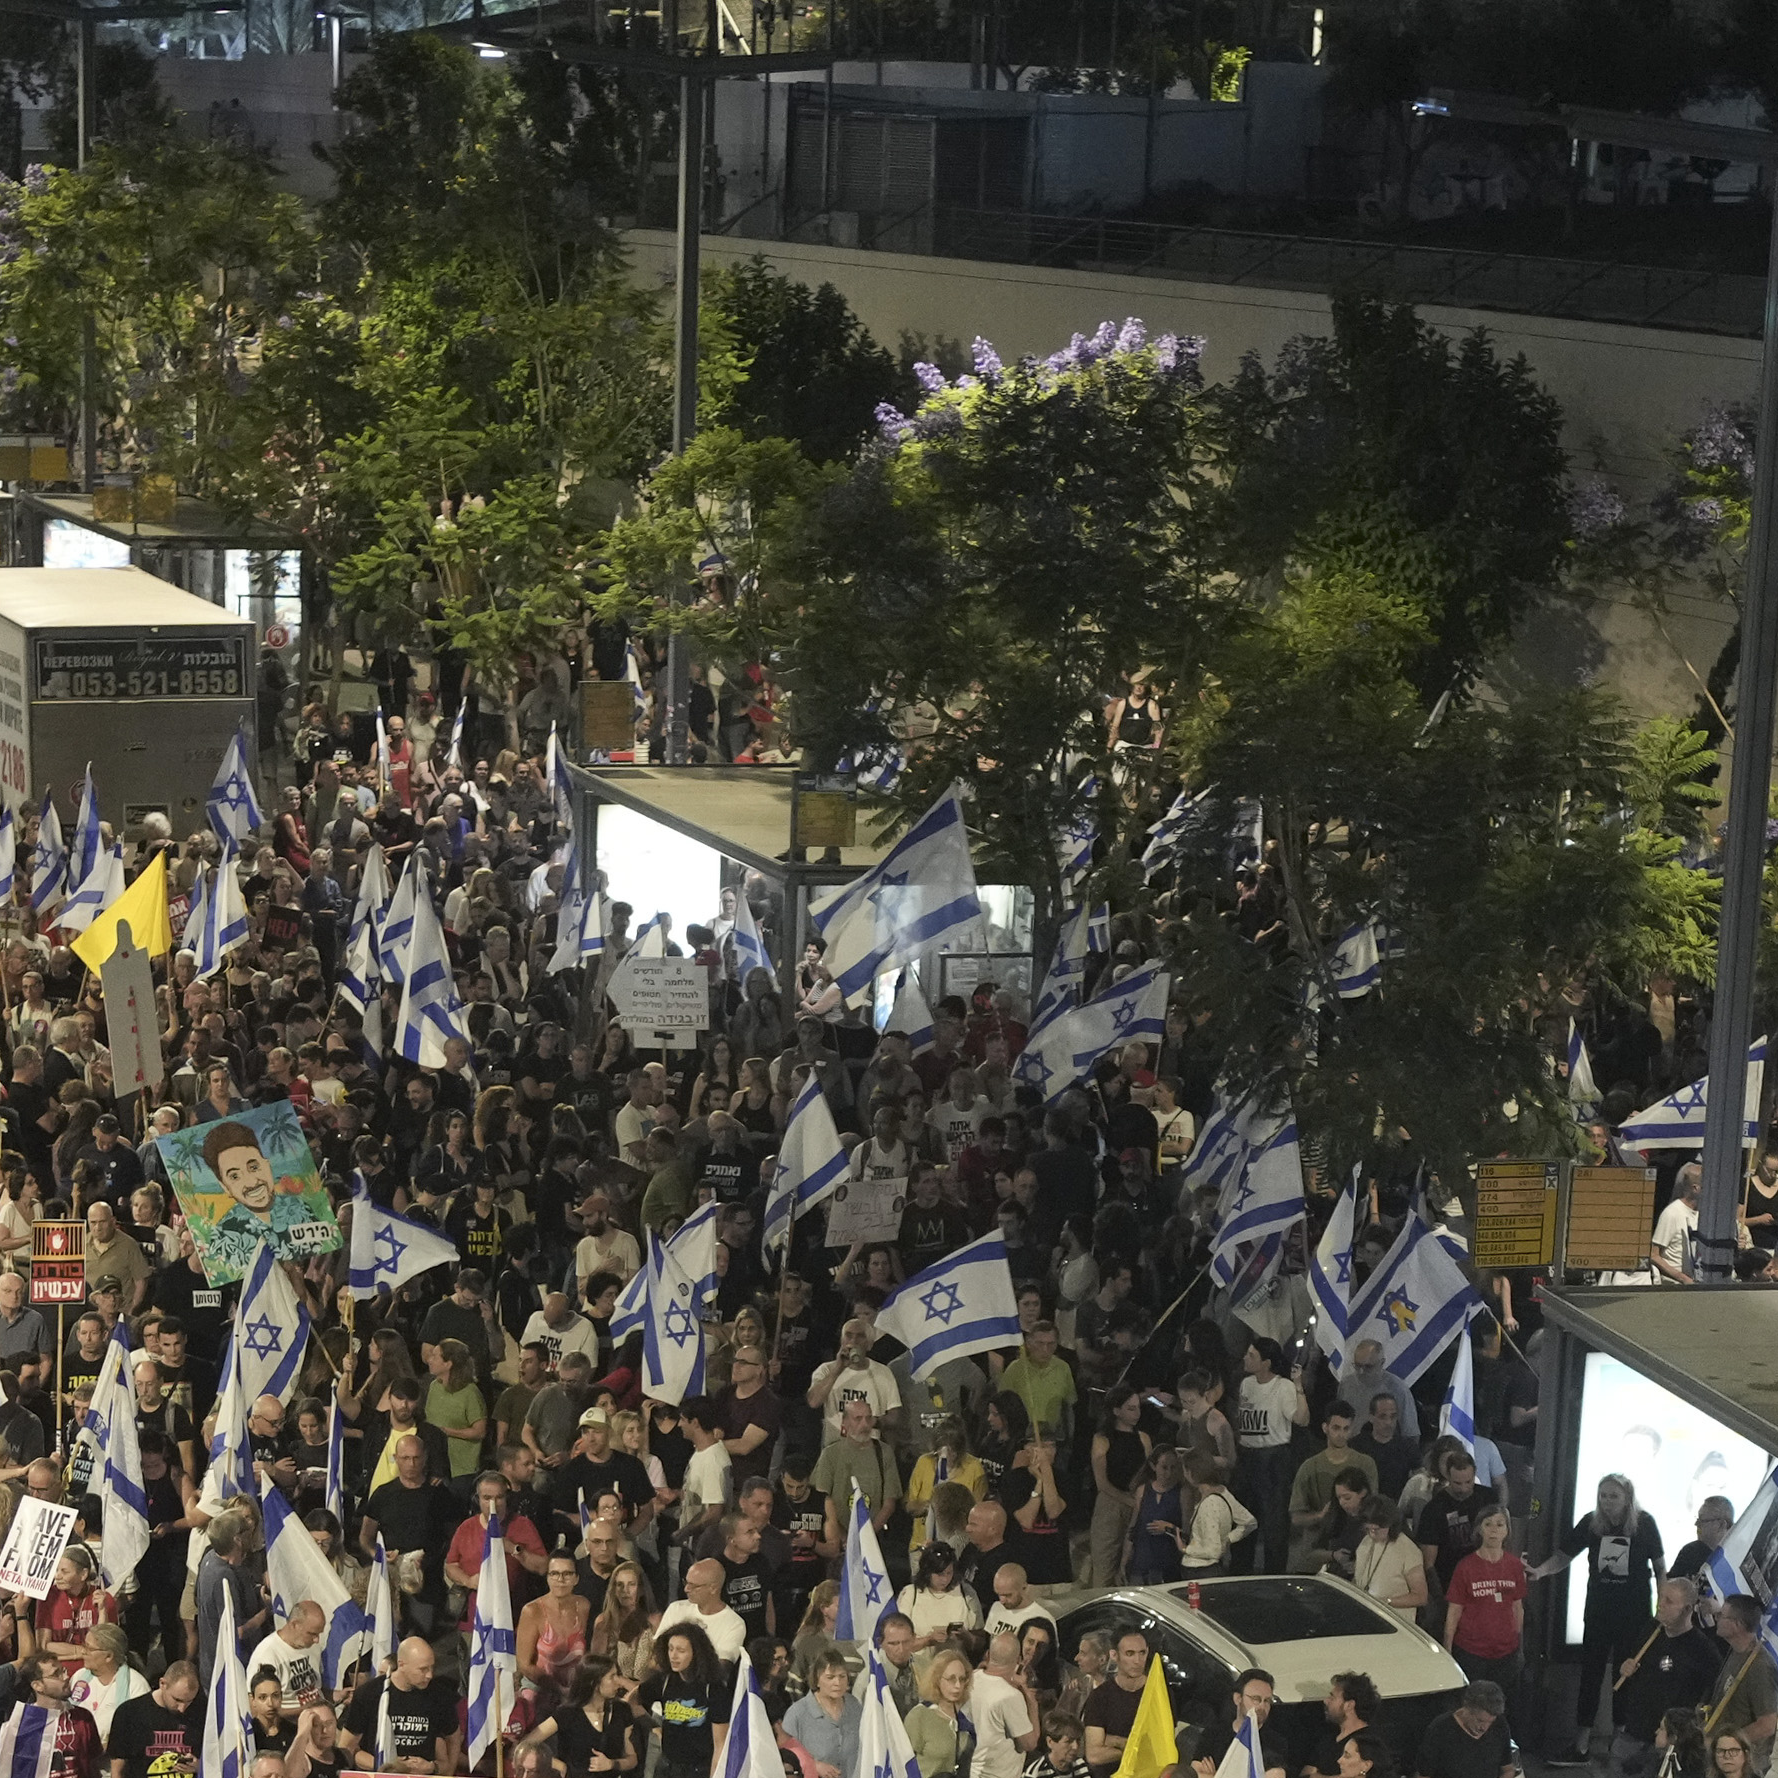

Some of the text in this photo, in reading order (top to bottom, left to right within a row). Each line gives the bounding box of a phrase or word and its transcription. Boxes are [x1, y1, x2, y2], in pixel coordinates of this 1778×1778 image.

[42, 654, 114, 668] ПЕРЕВОЗКИ
[70, 668, 238, 696] 053-521-8558
[658, 1012, 694, 1023] בגידה
[292, 1226, 330, 1241] הירש
[34, 1279, 83, 1301] עכשיו!
[1472, 1579, 1516, 1590] BRING THEM
